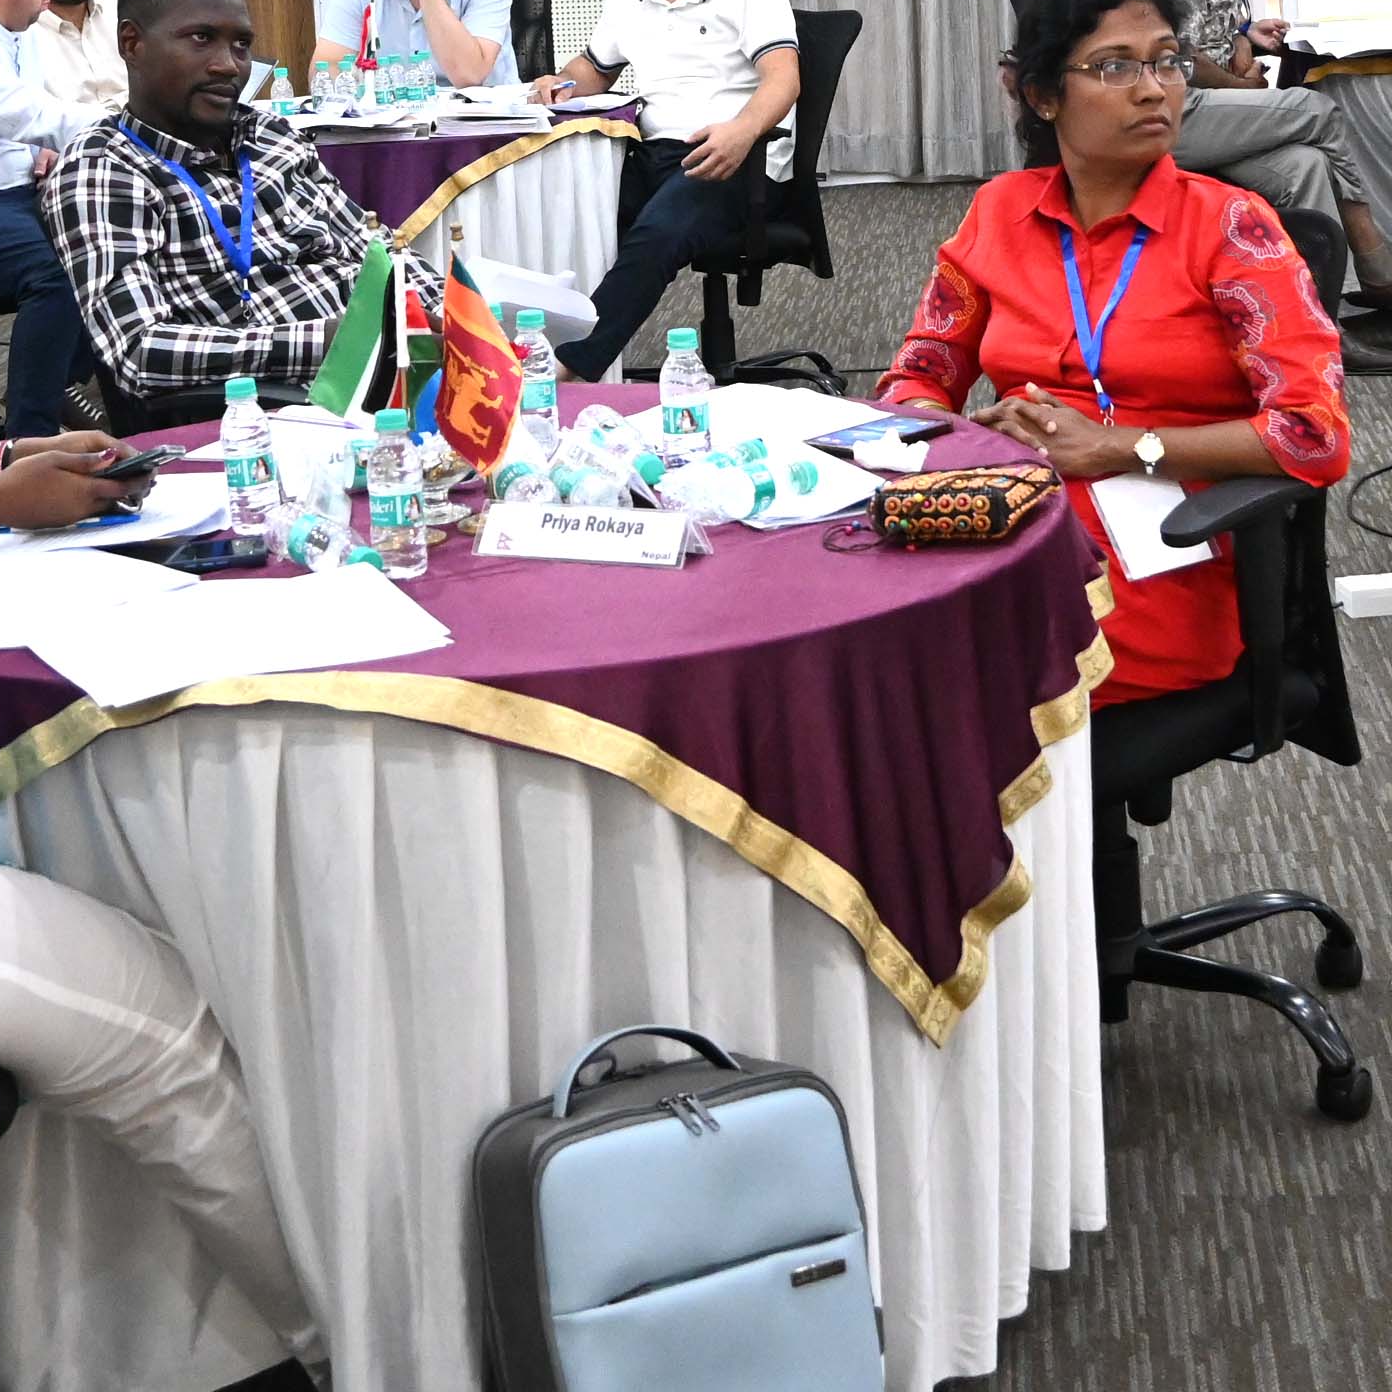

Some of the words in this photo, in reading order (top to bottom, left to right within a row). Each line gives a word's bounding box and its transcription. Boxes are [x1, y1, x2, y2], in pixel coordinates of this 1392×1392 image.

[541, 512, 581, 533] Priya
[585, 515, 645, 536] Rokaya
[641, 550, 672, 561] Nepal
